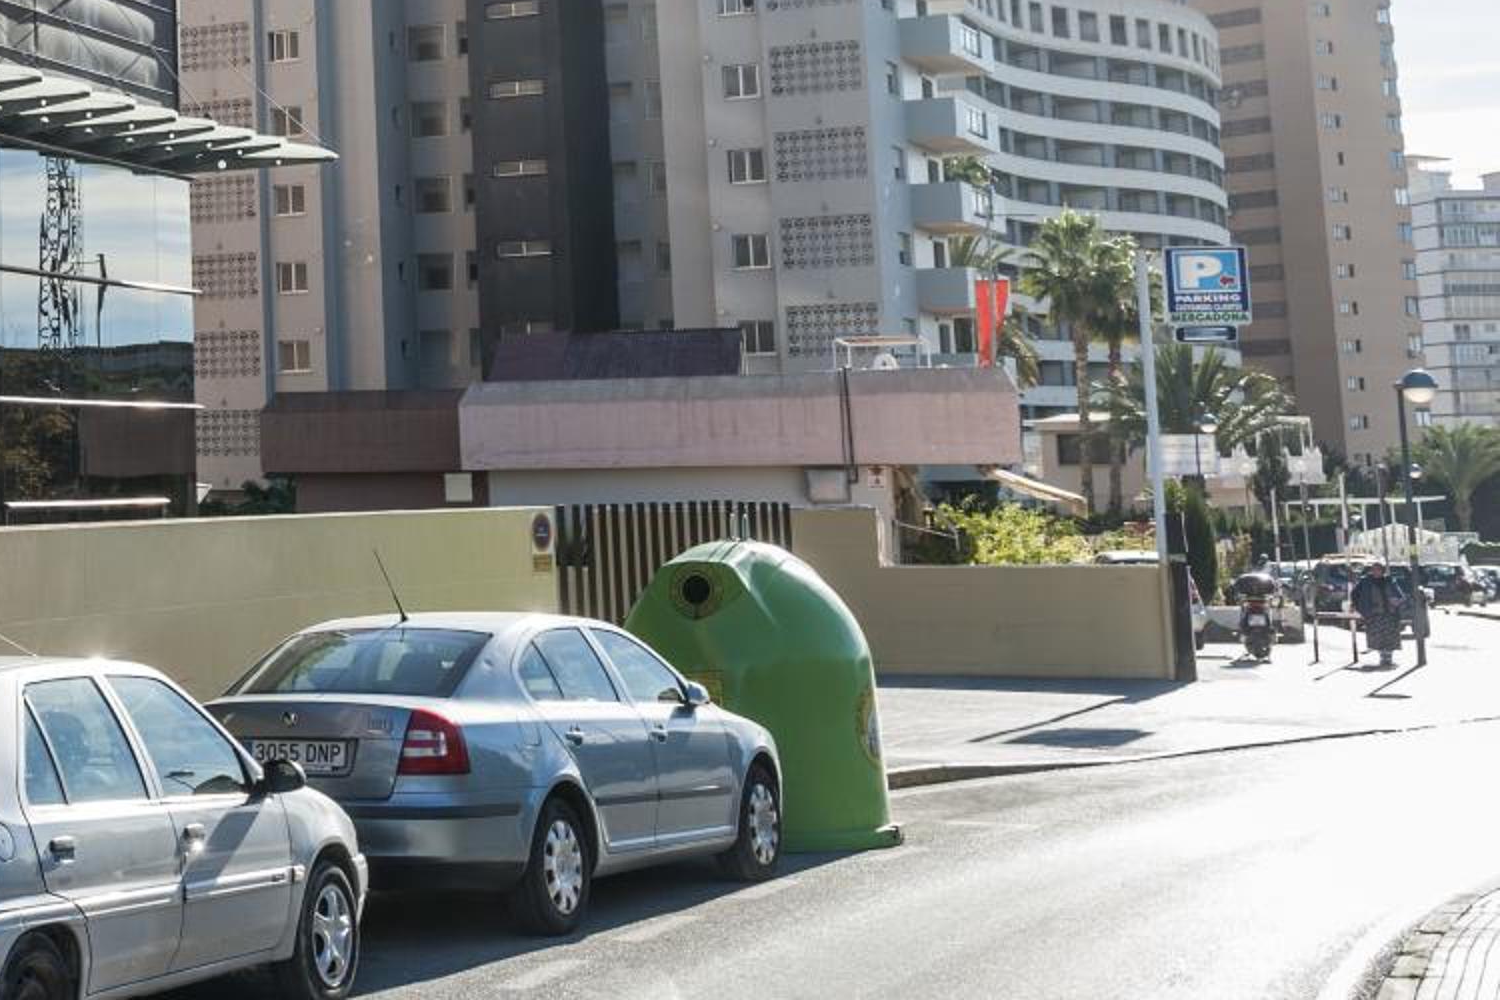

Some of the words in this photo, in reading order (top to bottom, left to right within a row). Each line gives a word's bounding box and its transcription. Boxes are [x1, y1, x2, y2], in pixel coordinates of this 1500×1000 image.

[1178, 255, 1221, 288] P
[1175, 294, 1242, 303] PARKING
[256, 743, 300, 761] 3055
[306, 744, 340, 763] DNP
